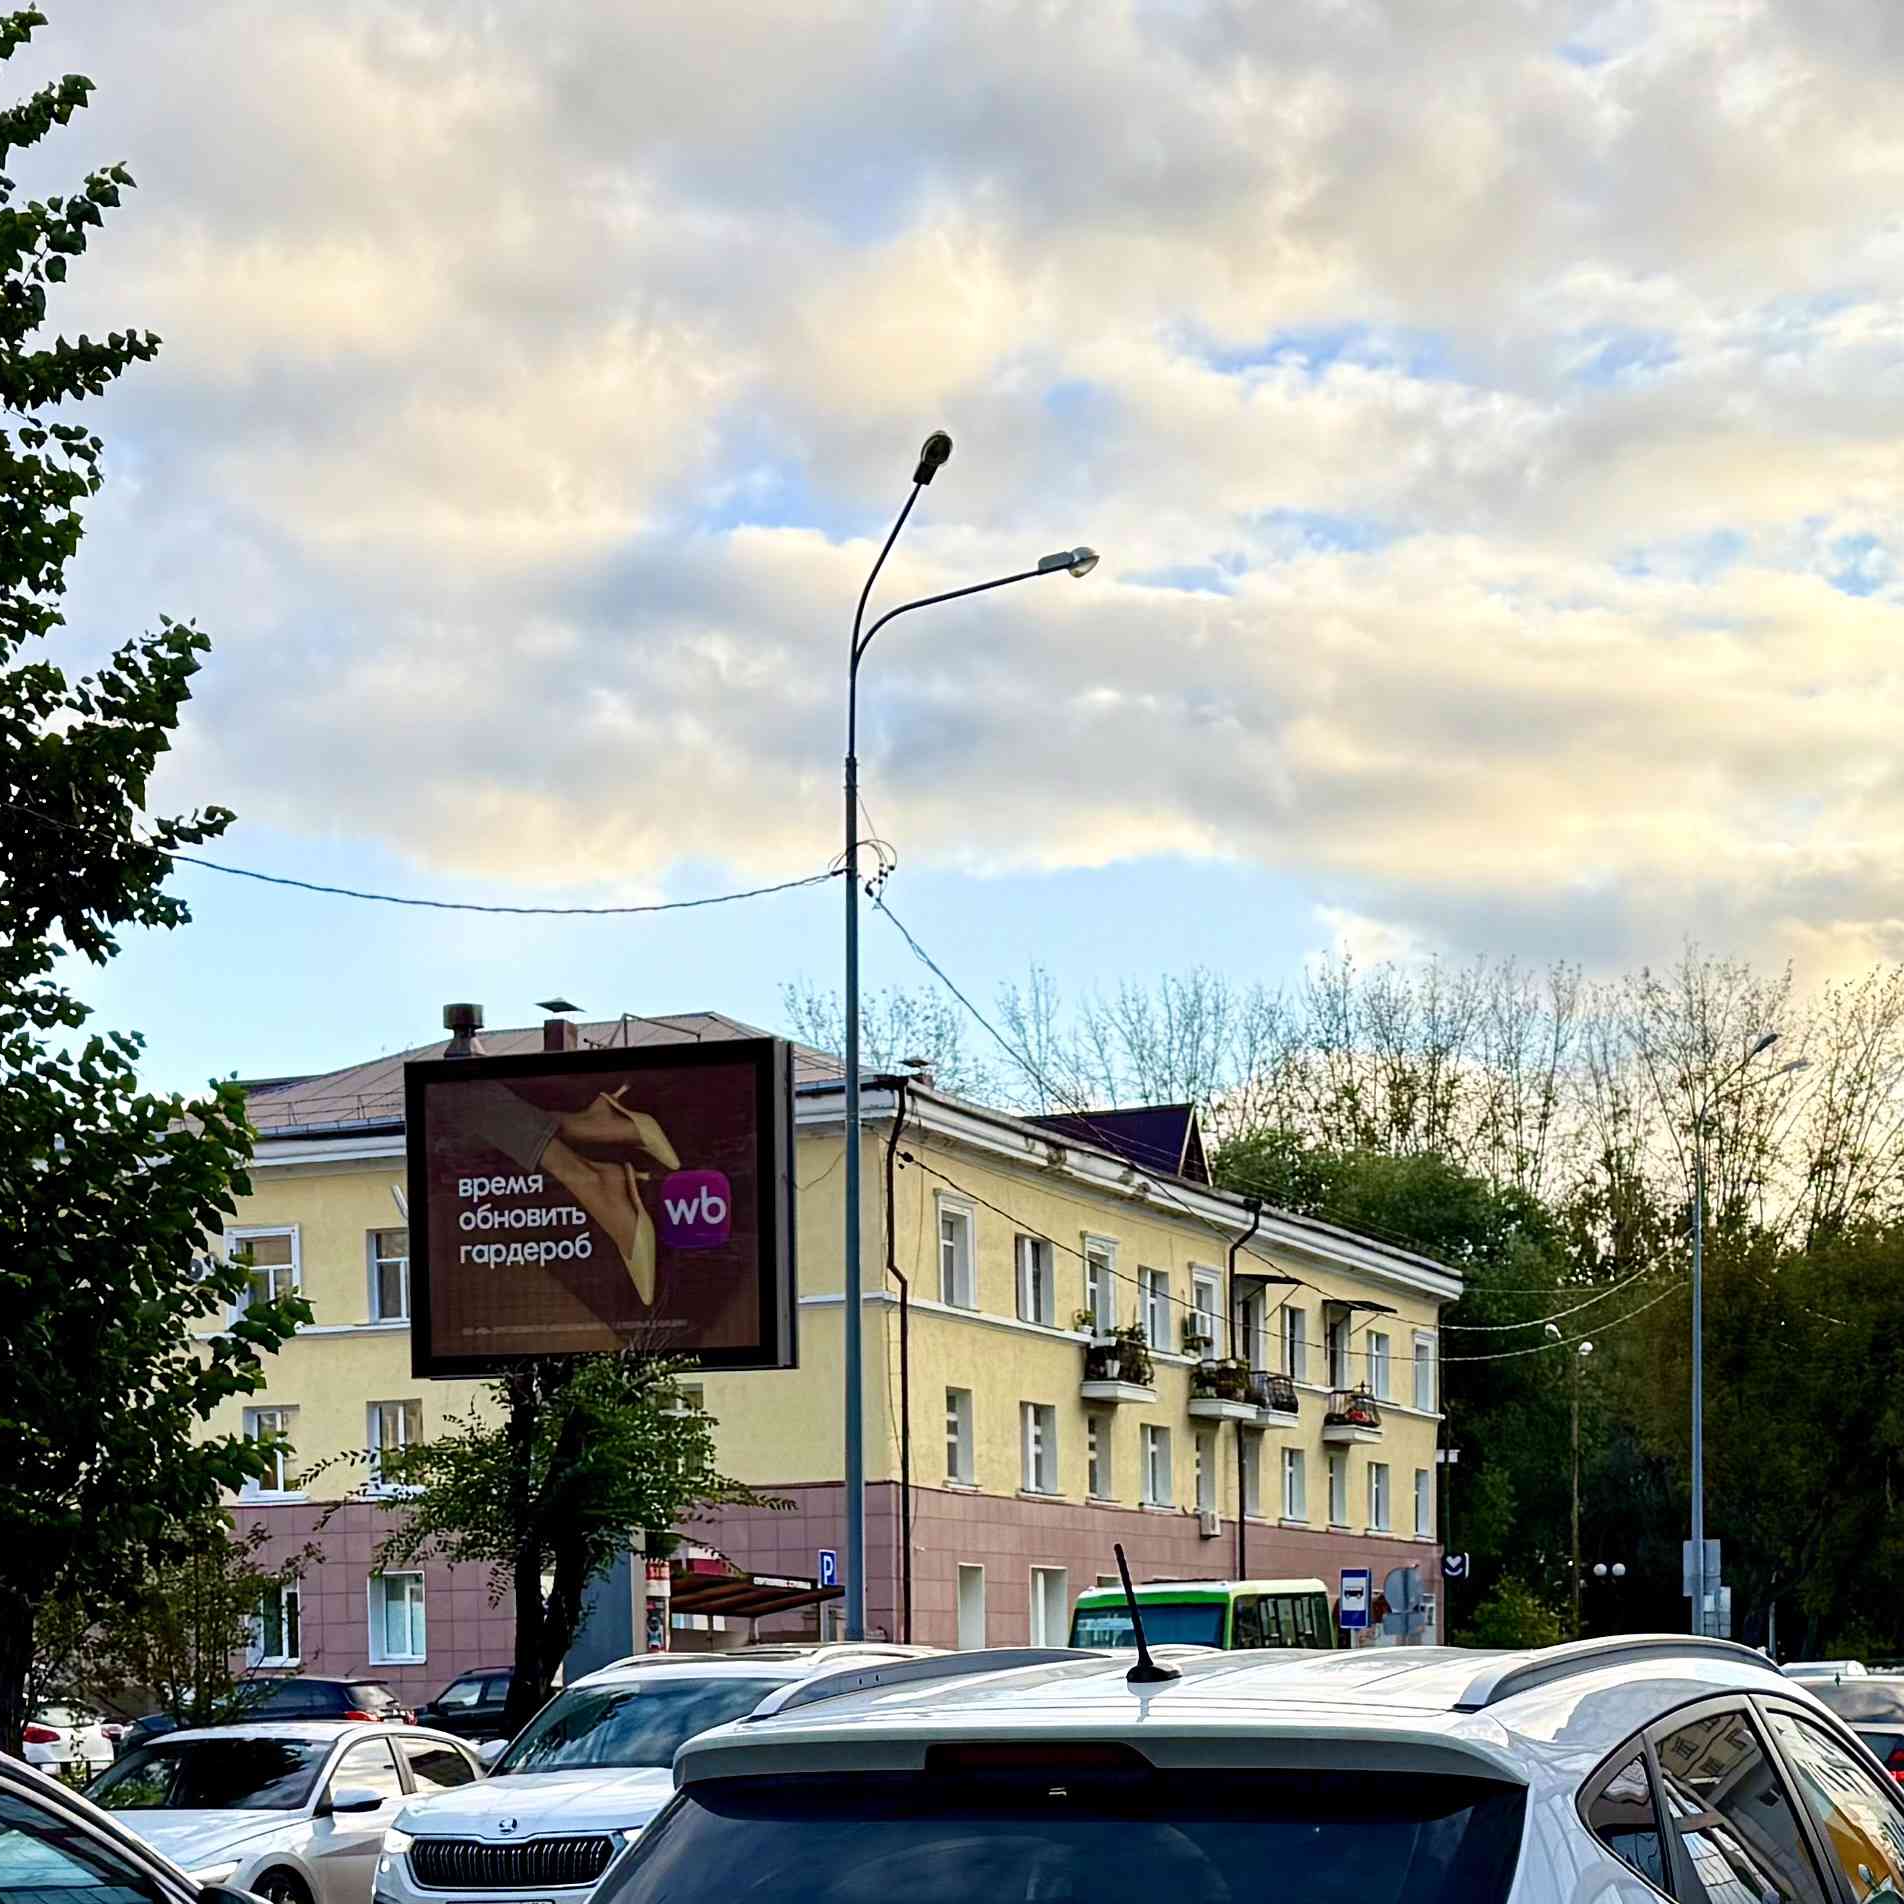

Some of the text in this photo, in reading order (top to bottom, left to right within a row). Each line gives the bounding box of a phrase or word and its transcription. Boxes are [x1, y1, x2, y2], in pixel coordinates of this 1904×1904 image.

[458, 1174, 543, 1202] время
[458, 1204, 587, 1231] обновить
[665, 1186, 727, 1225] wb
[459, 1232, 593, 1270] гардероб
